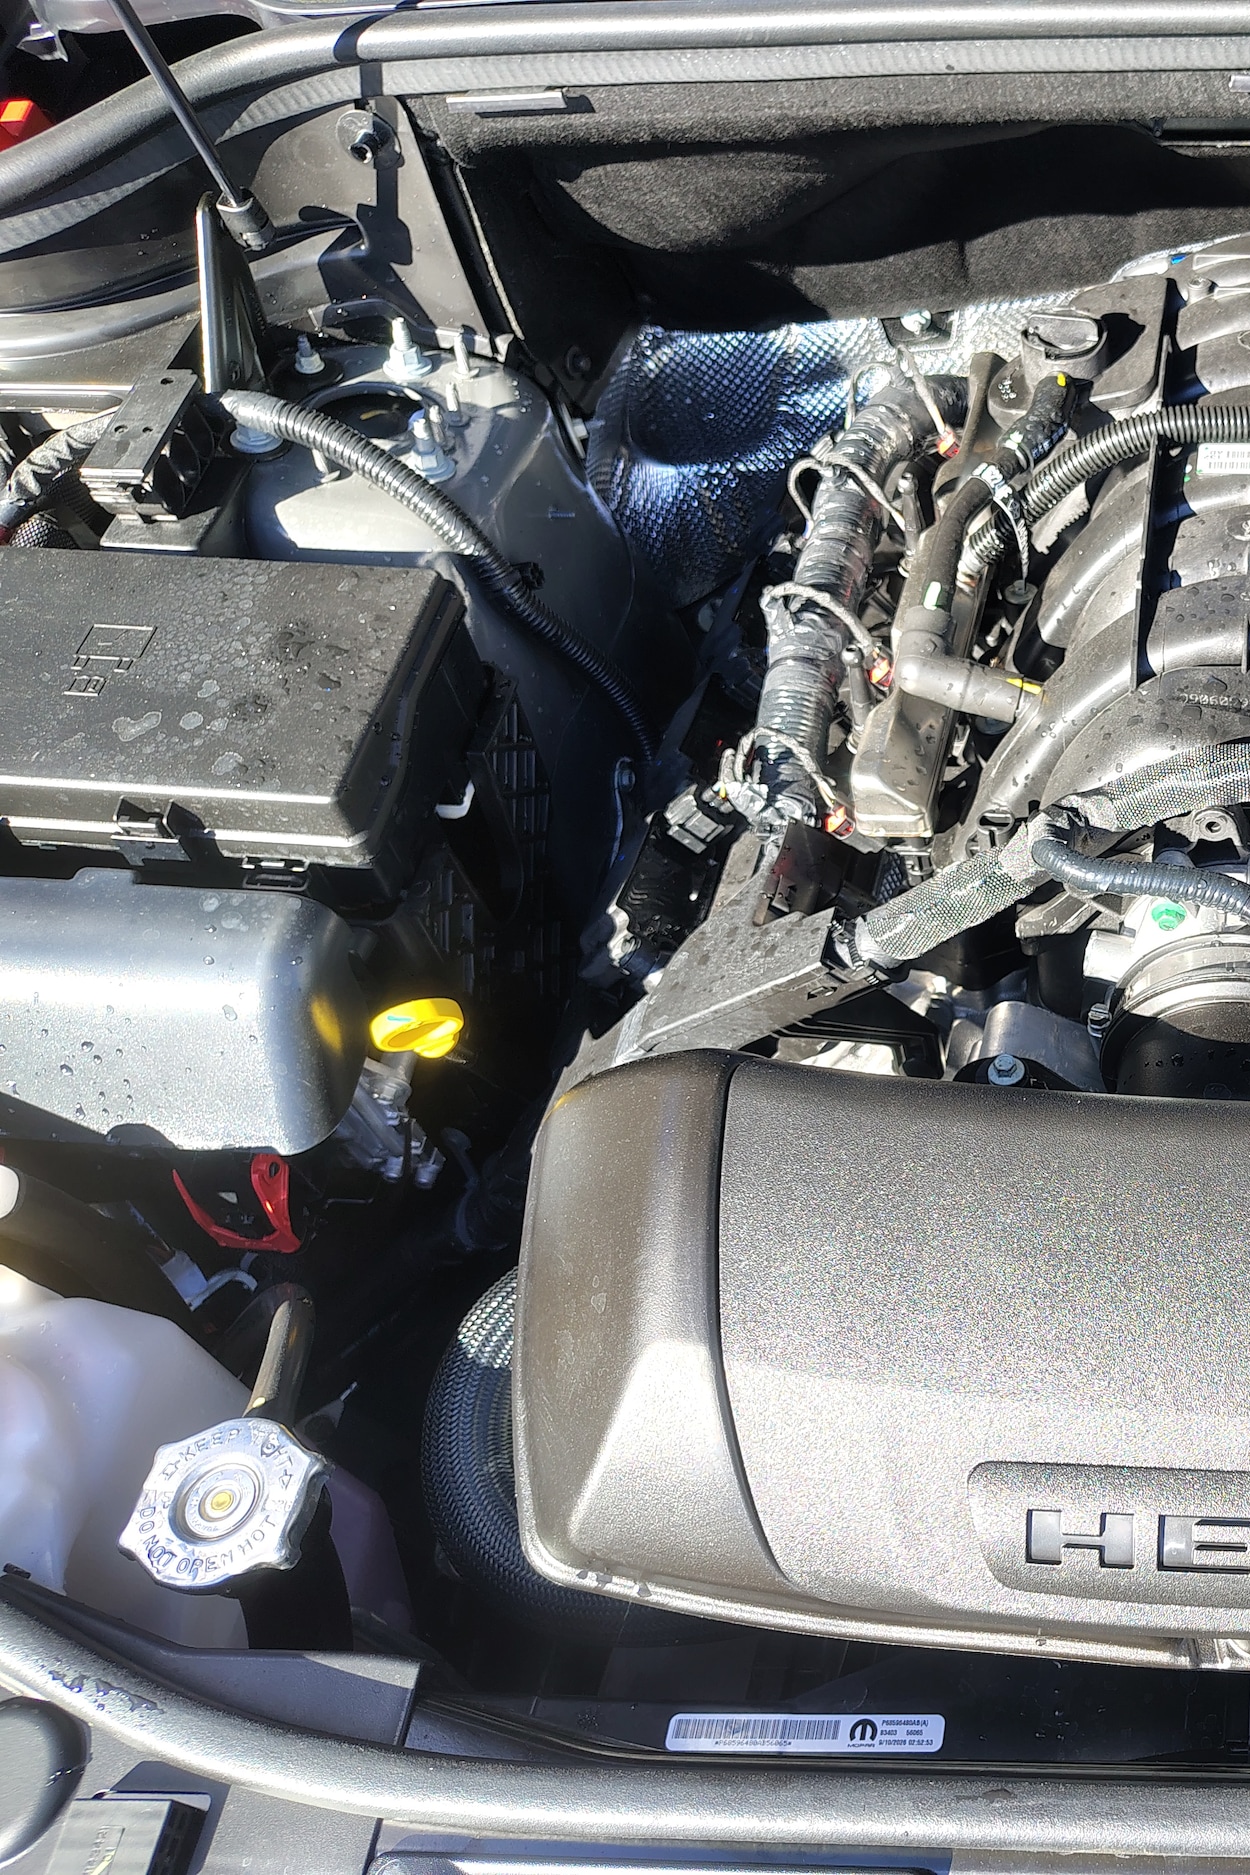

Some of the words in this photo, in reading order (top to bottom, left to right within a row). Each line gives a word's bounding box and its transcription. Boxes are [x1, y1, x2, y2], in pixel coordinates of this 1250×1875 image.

[179, 1427, 241, 1462] KEEP
[139, 1506, 156, 1534] DO
[239, 1514, 276, 1555] HOT
[144, 1535, 178, 1568] NOT
[176, 1553, 234, 1576] OPEN
